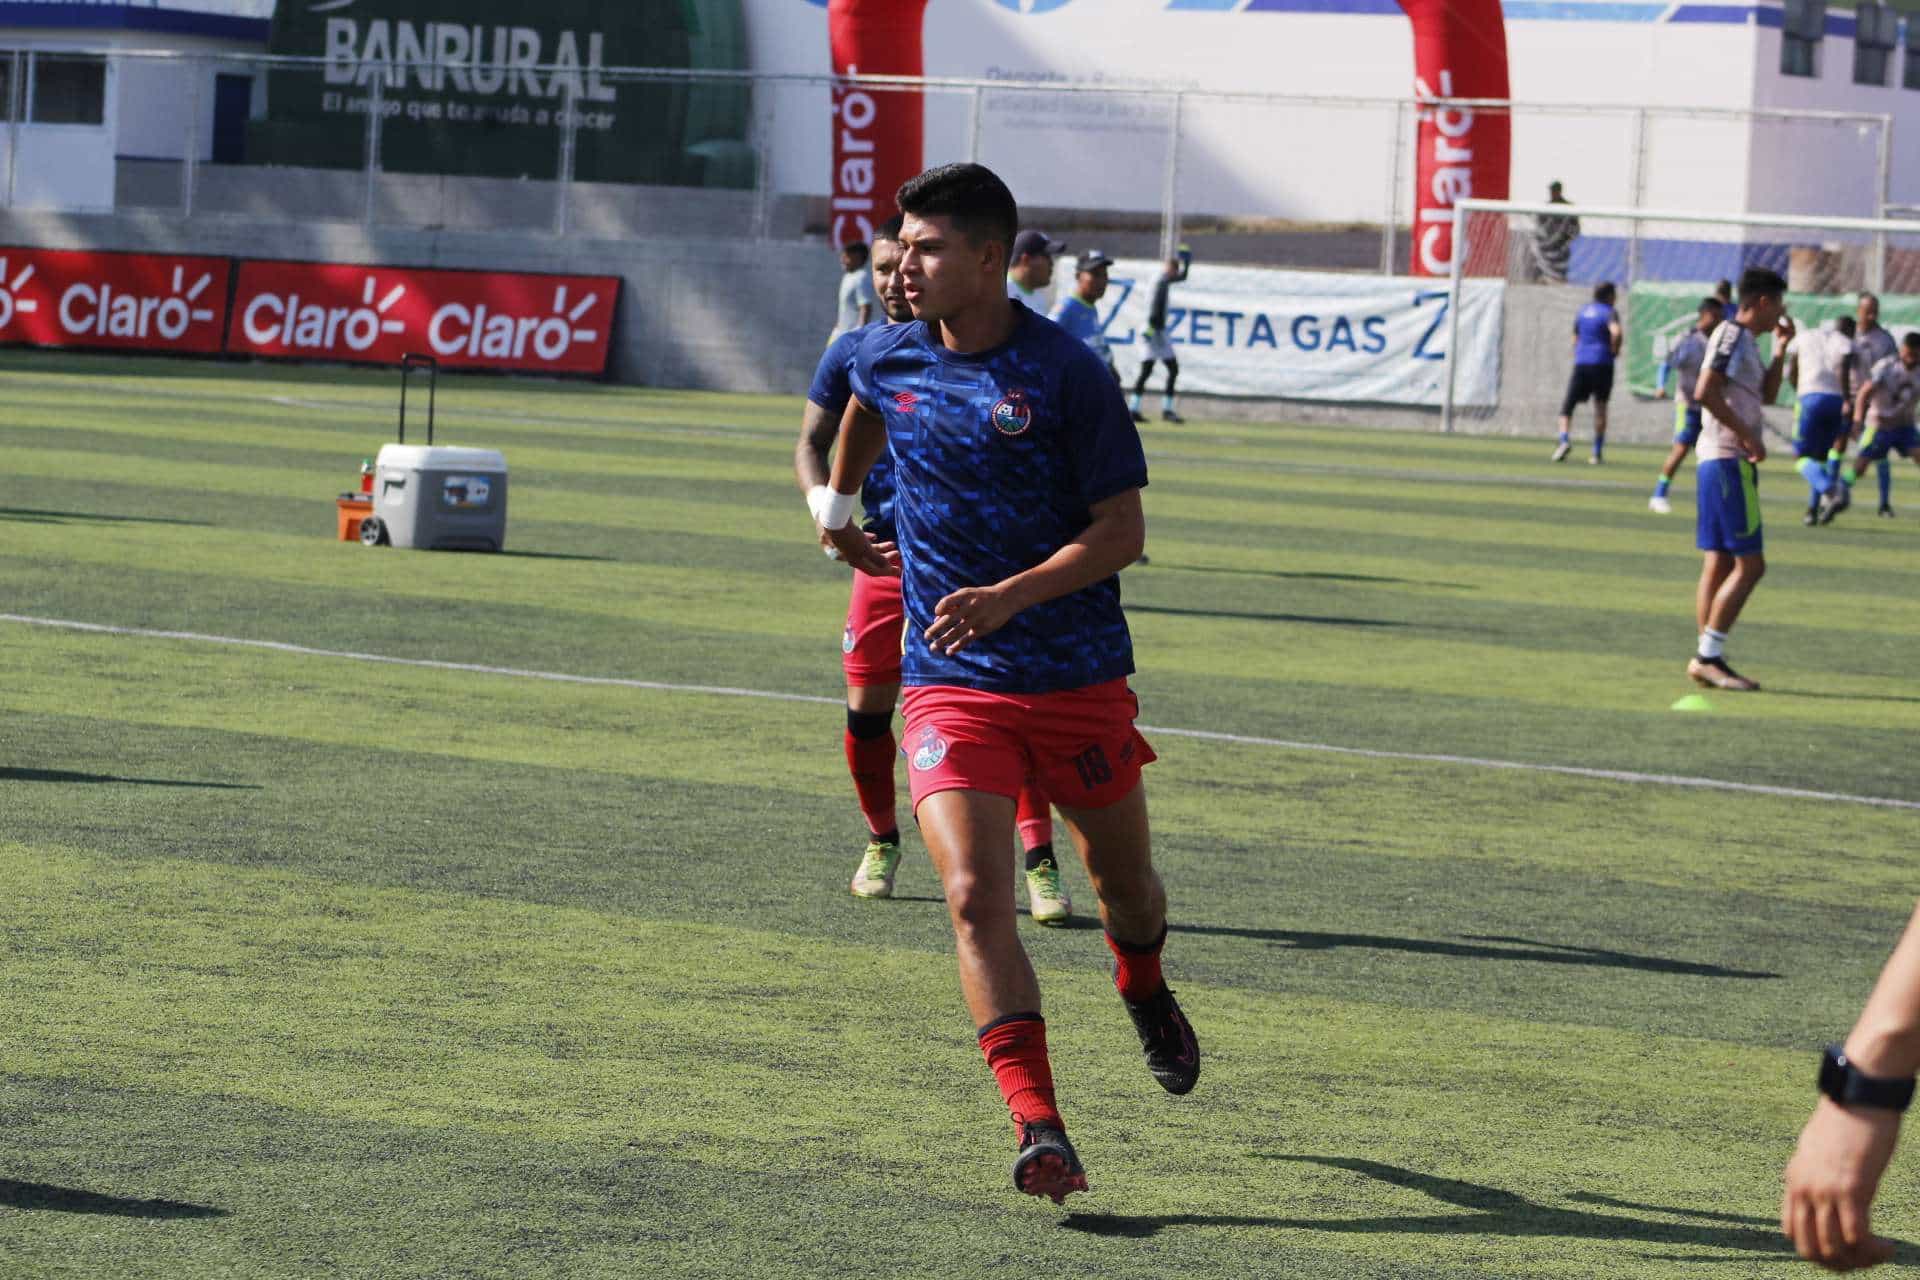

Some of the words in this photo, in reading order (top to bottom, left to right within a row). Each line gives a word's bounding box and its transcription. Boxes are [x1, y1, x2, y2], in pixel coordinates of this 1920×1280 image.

[324, 17, 616, 101] BANRURAL
[832, 91, 876, 252] Claro
[1419, 104, 1473, 275] Claro
[59, 282, 189, 339] Claro
[243, 292, 380, 350] Claro
[428, 302, 571, 361] Claro
[1166, 306, 1278, 349] ZETA
[1290, 314, 1387, 354] GAS
